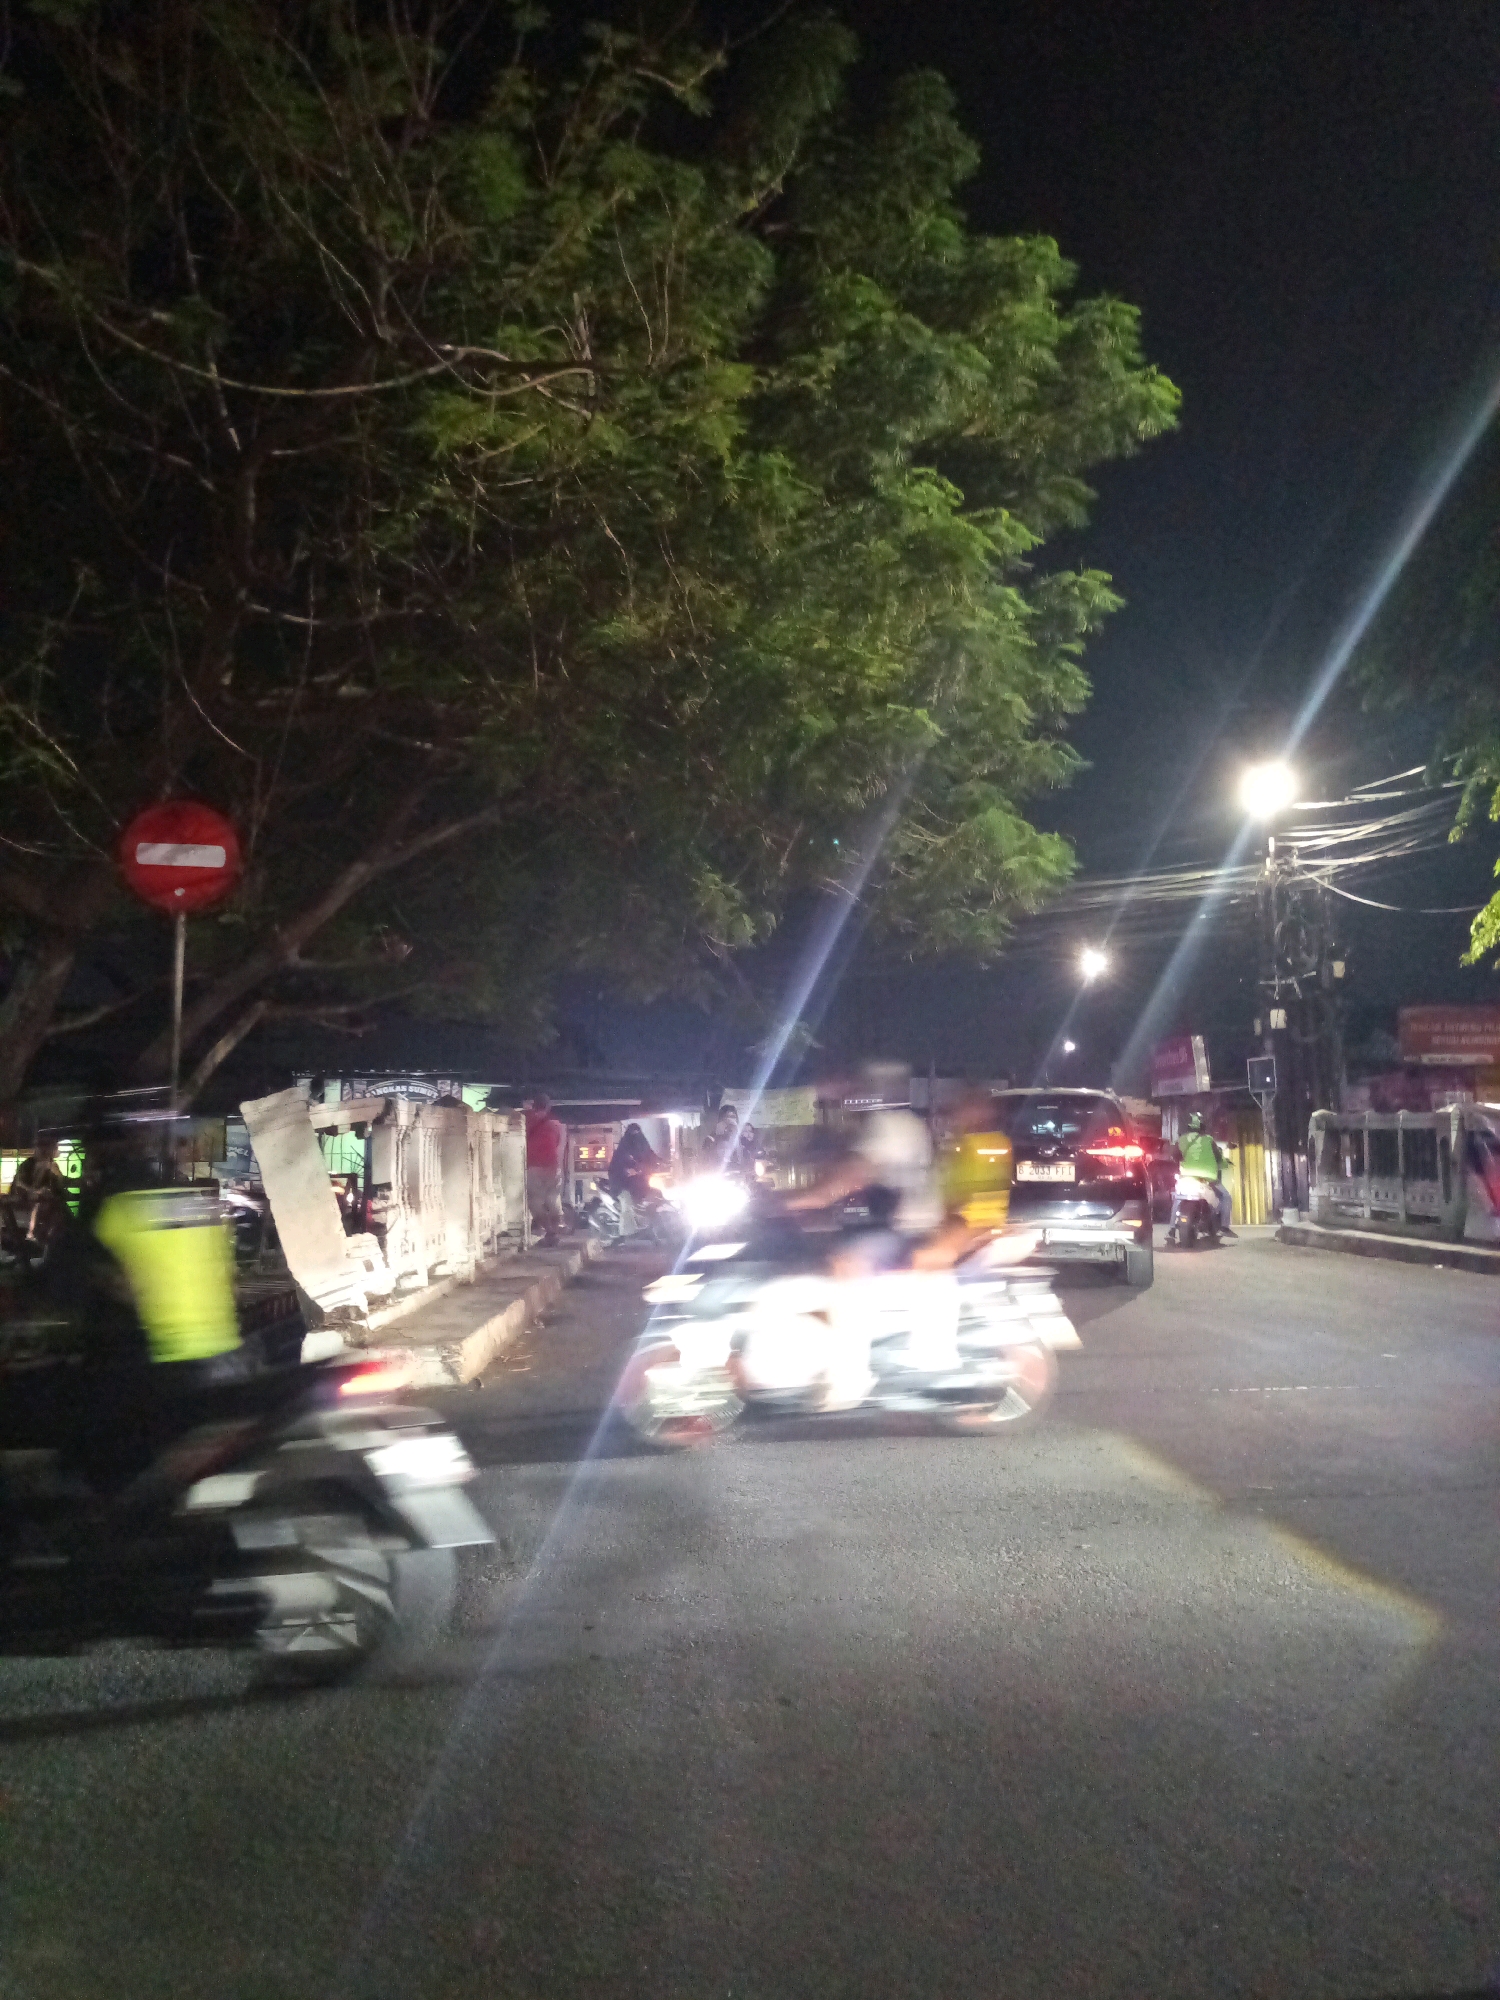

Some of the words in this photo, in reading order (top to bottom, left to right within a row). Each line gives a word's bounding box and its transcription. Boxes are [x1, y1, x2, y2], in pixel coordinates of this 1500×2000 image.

[369, 1085, 407, 1096] ANGKAS
[408, 1085, 439, 1099] SUMUT
[1018, 1165, 1024, 1175] B
